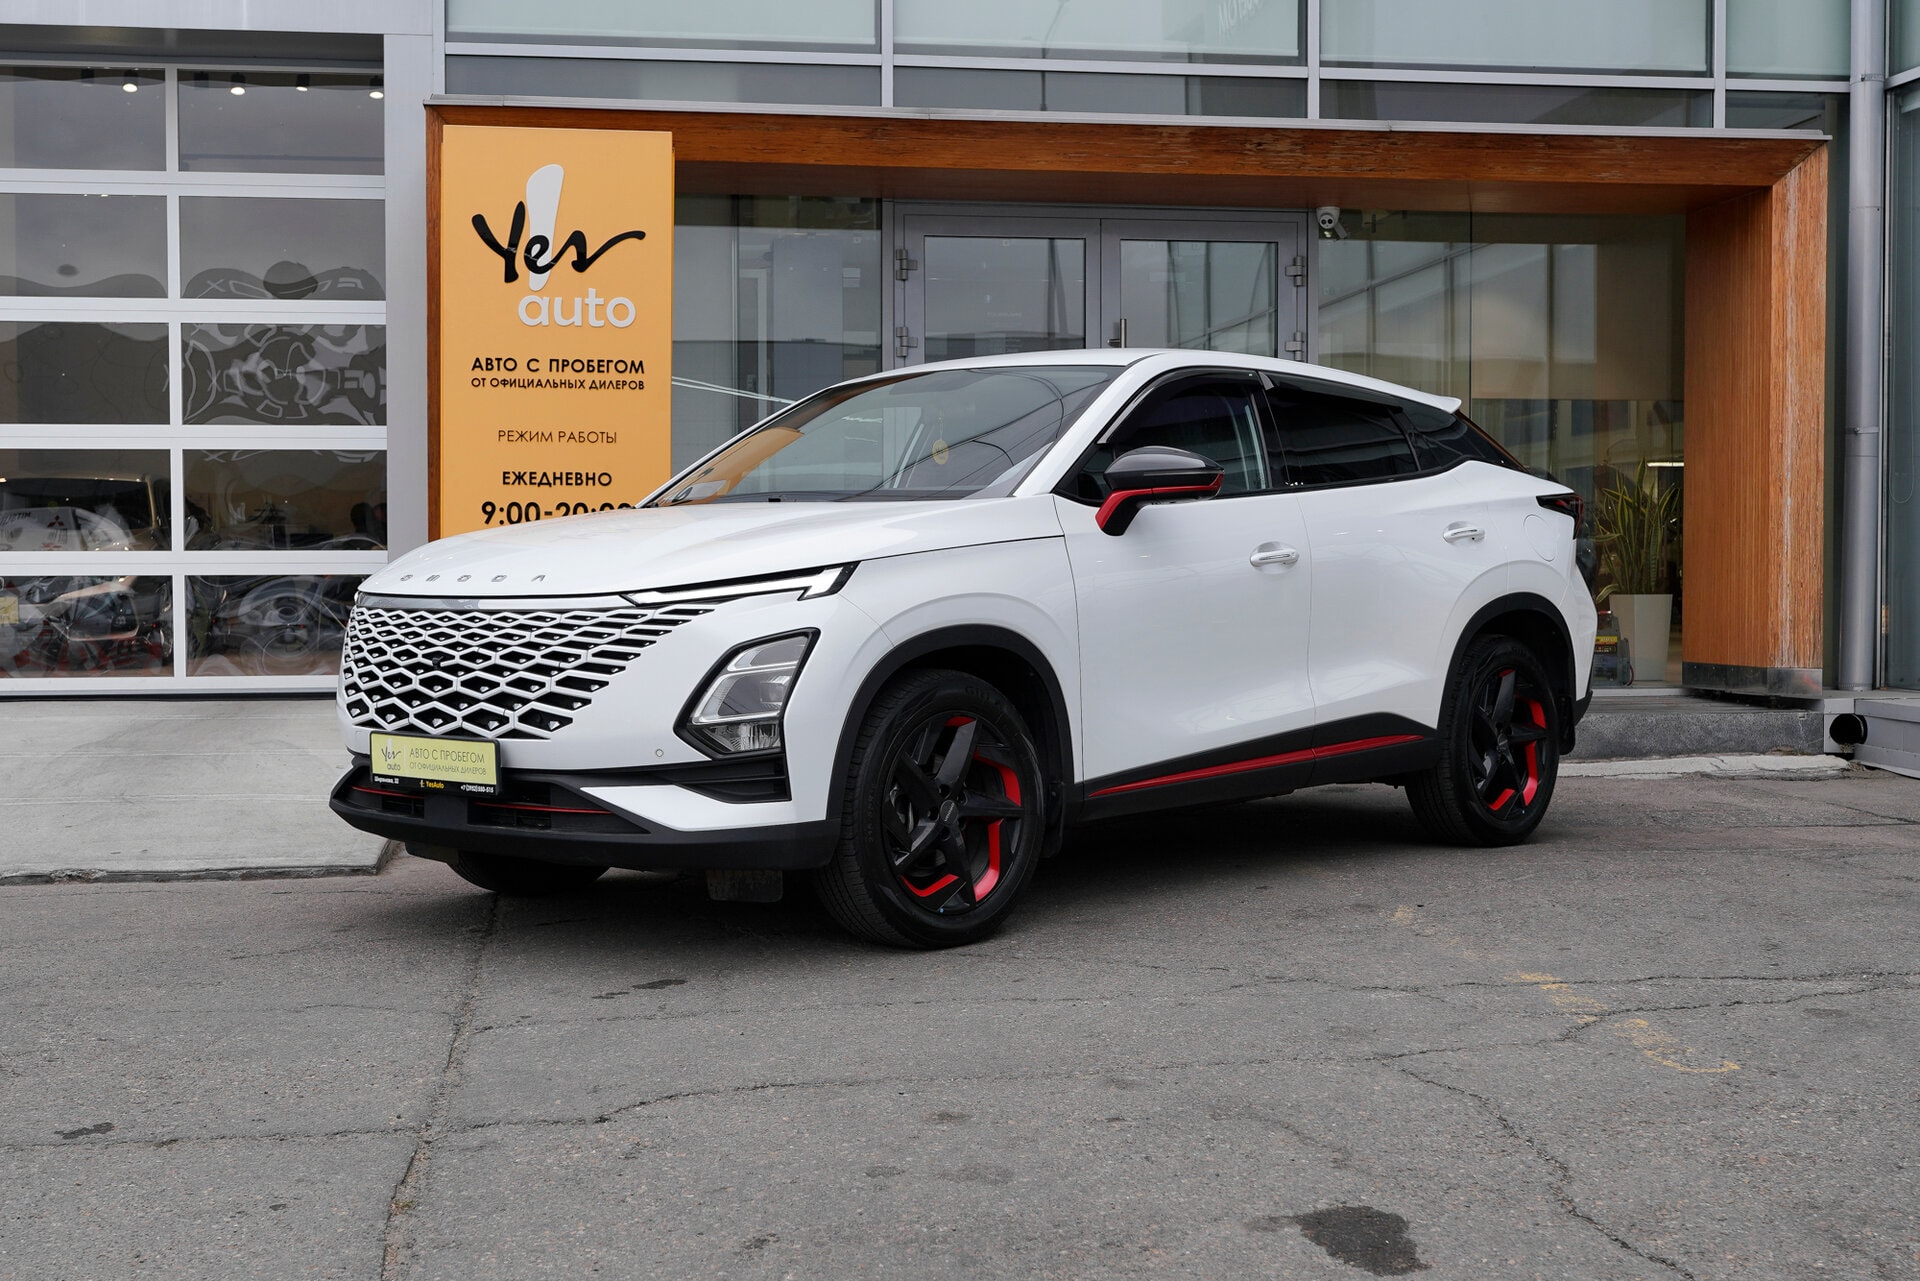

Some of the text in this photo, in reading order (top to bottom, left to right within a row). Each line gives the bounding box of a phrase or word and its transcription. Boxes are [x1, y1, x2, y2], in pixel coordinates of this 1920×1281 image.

[471, 200, 646, 283] Yes
[518, 288, 636, 328] auto
[471, 357, 645, 374] АВТО С ПРОБЕГОМ
[471, 377, 645, 390] ОТ ОФИЦИАЛЬНЫХ ДИЛЕРОВ
[498, 430, 617, 444] РЕЖИМ РАБОТЫ
[502, 471, 612, 488] ЕЖЕДНЕВНО
[409, 748, 485, 763] АВТО С ПРОБЕГОМ
[387, 763, 401, 771] auto
[409, 762, 418, 770] ОТ
